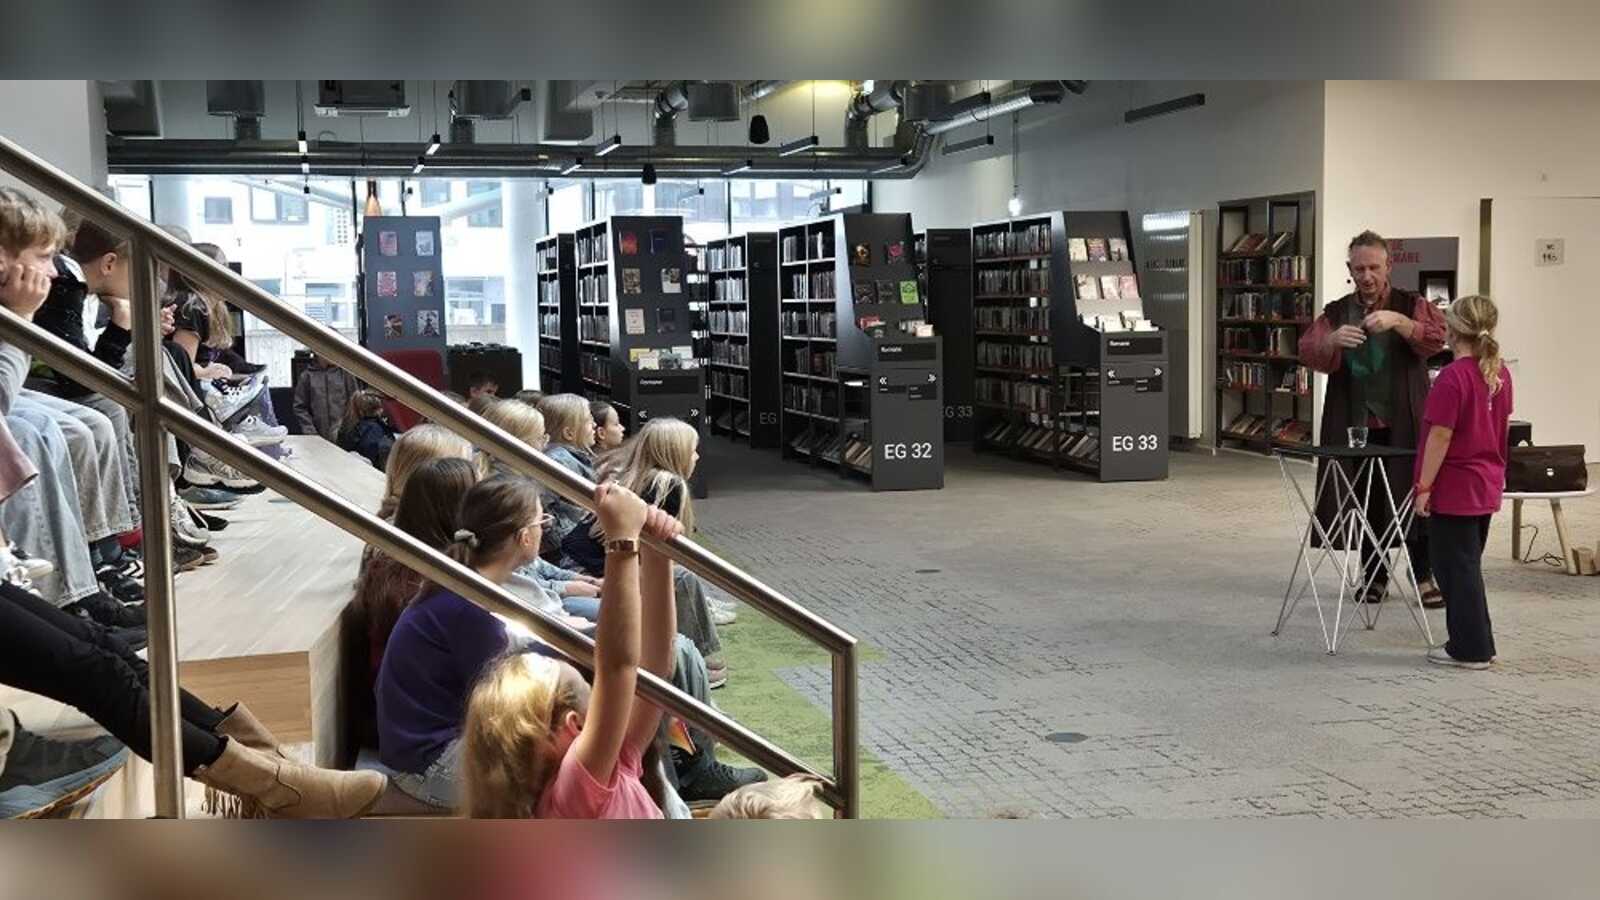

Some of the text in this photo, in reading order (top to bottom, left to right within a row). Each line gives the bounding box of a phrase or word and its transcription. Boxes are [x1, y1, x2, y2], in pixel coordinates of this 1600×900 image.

[759, 411, 777, 425] EG
[943, 405, 974, 418] G 33
[884, 442, 932, 460] EG 32
[1112, 434, 1158, 452] EG 33
